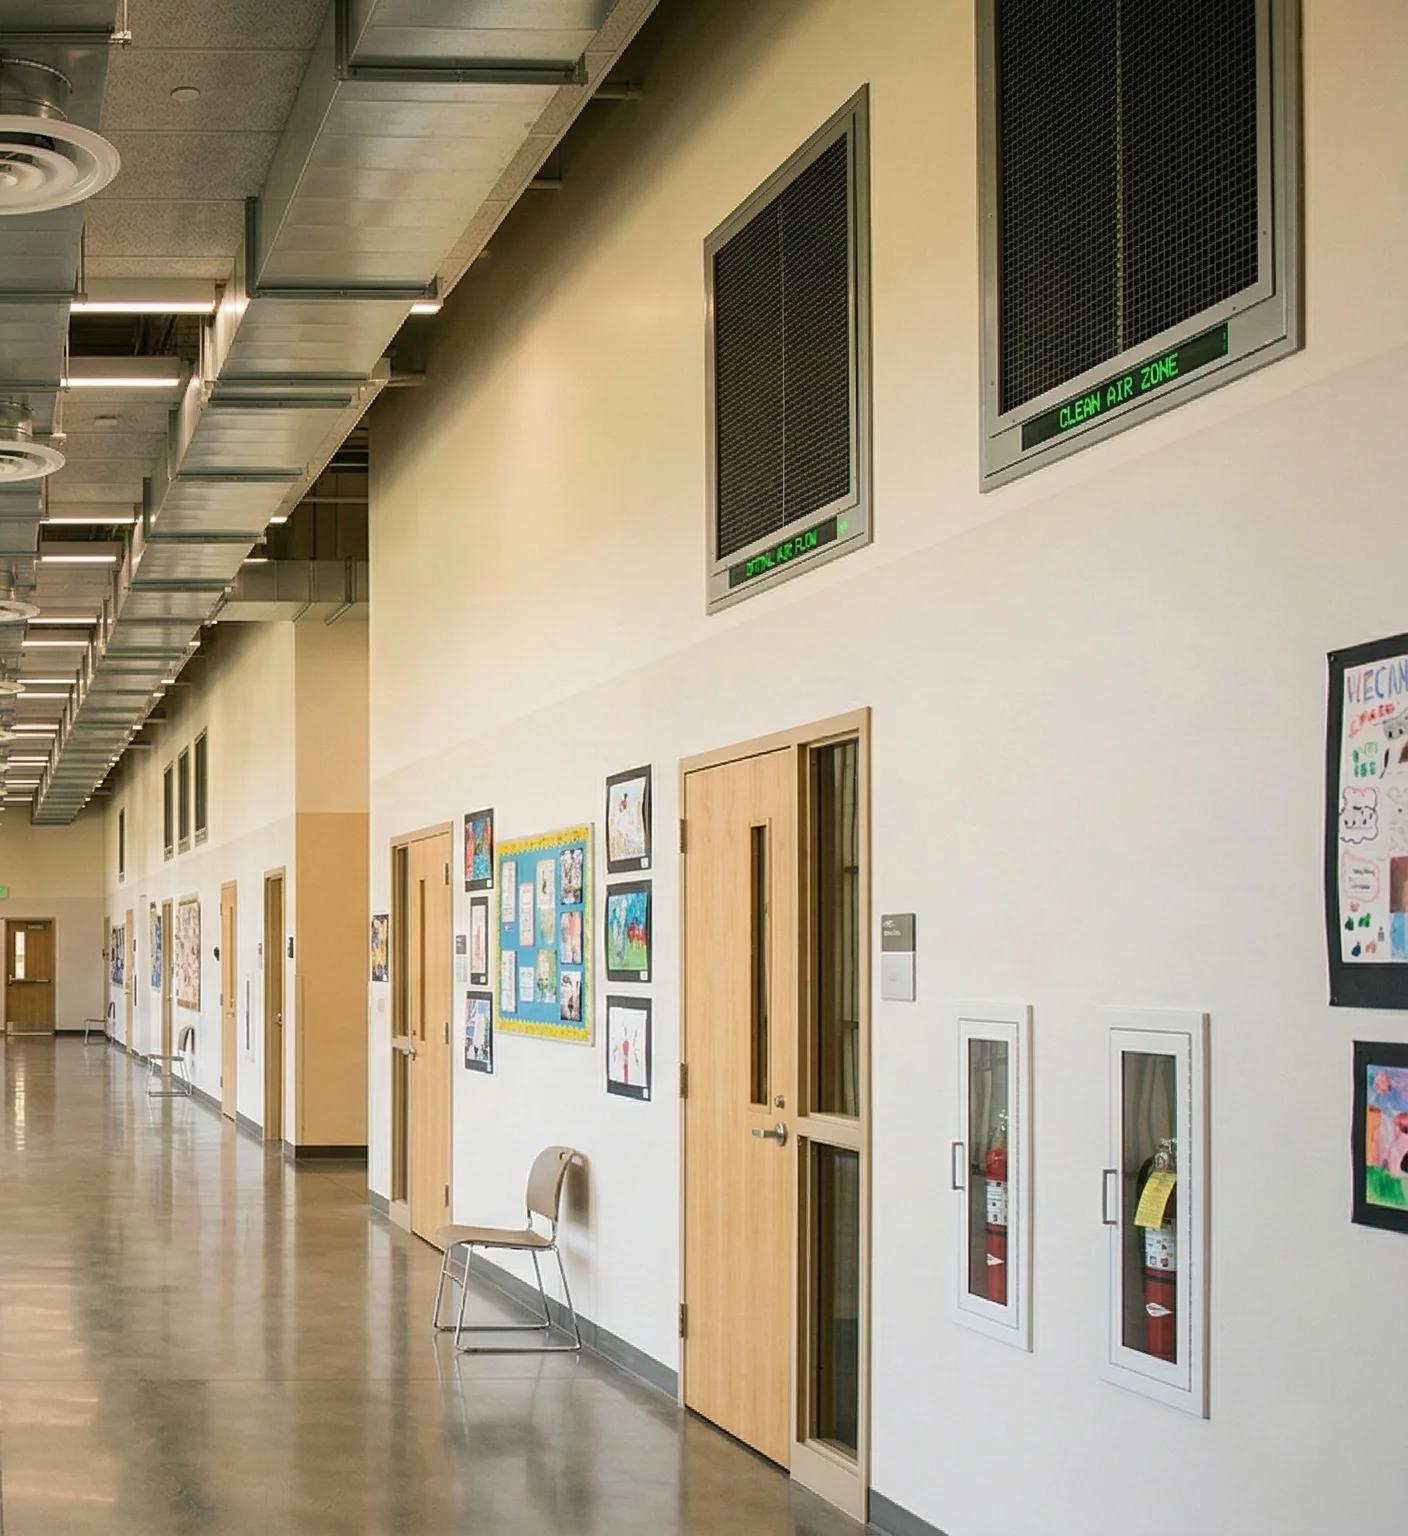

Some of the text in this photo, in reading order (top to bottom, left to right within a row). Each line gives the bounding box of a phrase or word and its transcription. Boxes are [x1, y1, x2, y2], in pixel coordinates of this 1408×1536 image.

[1059, 352, 1179, 429] CLEAN AIR ZONE
